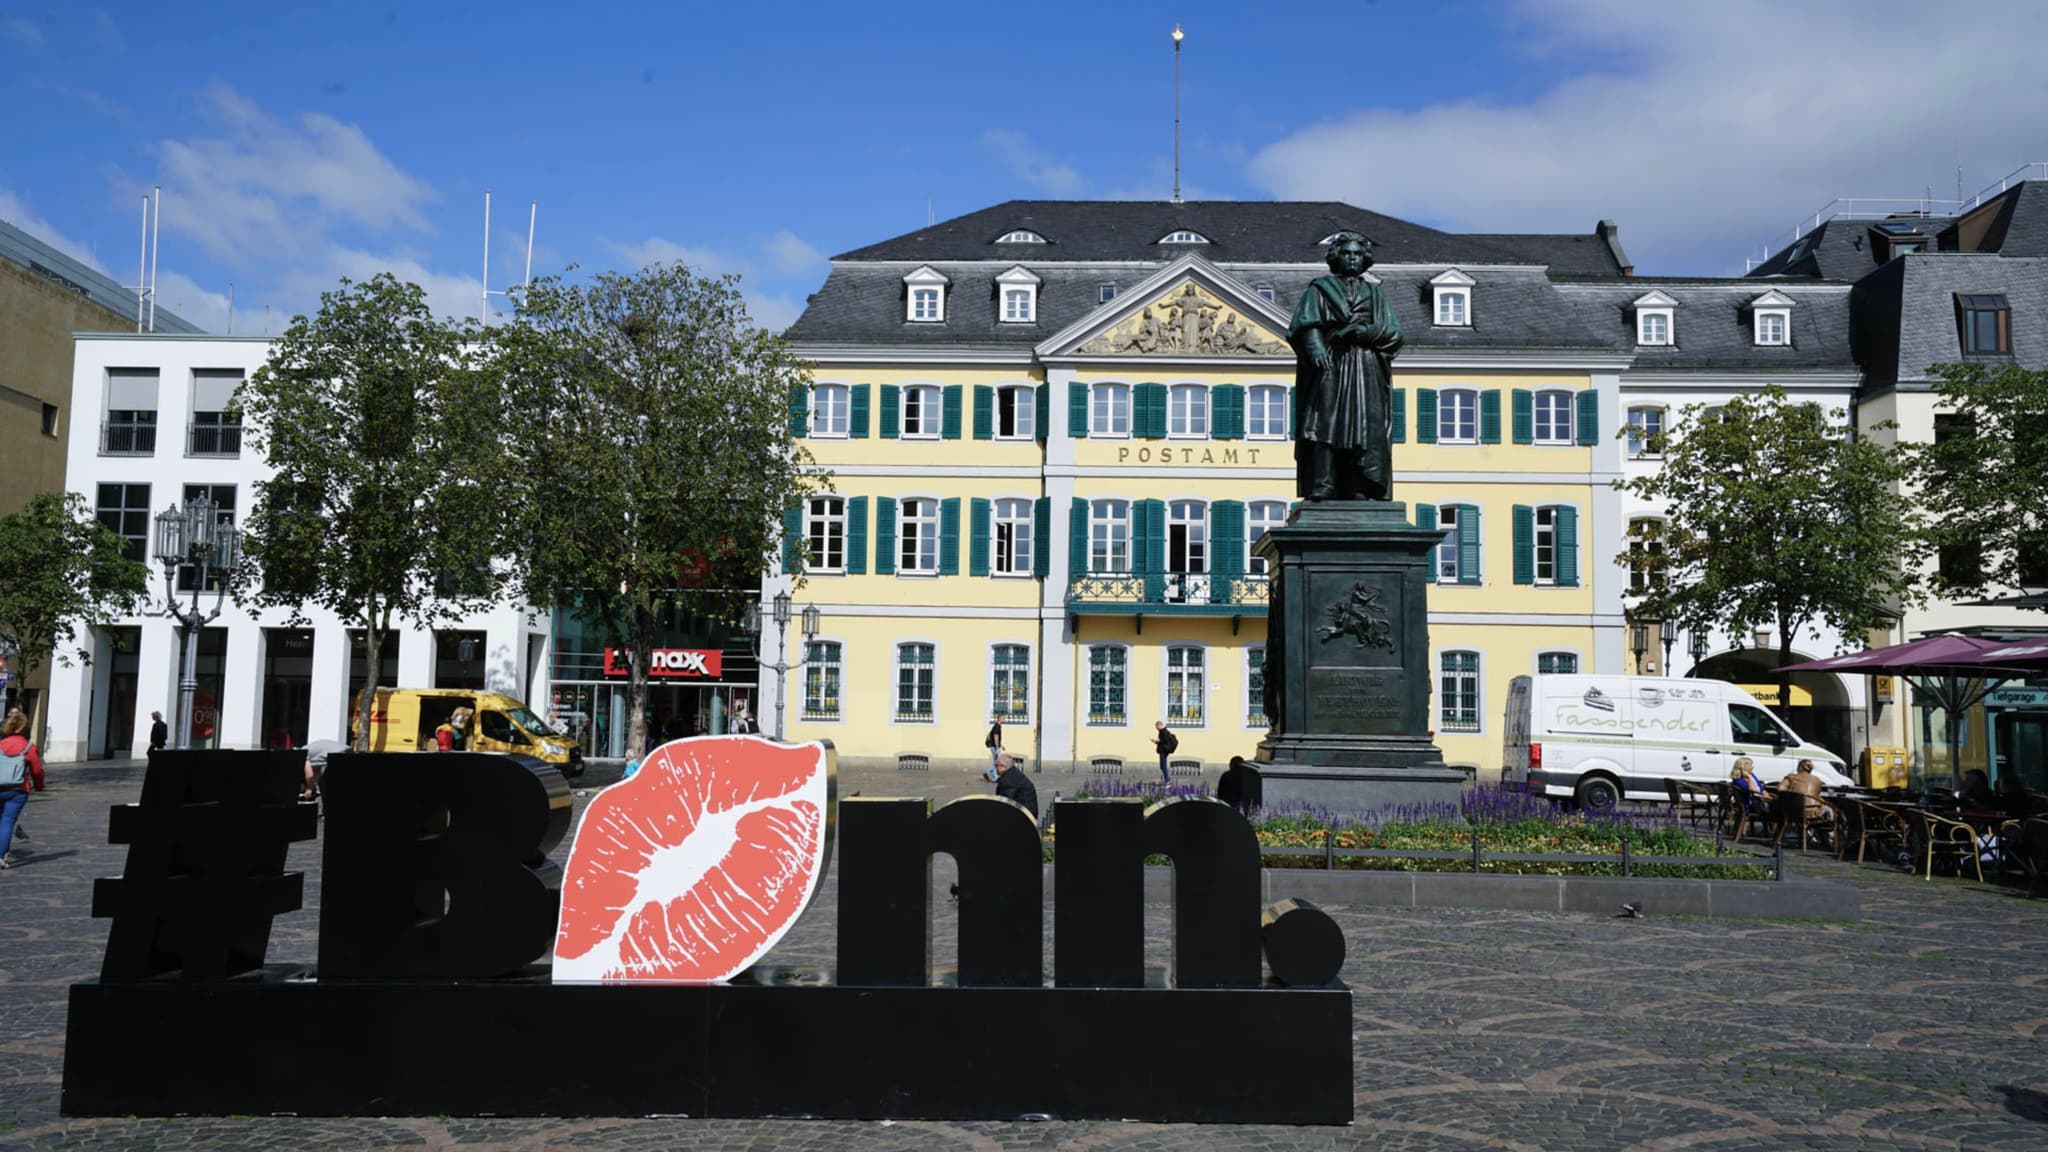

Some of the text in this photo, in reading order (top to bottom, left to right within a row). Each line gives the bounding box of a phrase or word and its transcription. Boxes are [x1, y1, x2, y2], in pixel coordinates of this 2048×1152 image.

[1118, 447, 1260, 464] POSTAMT
[1992, 690, 2036, 704] Tiefgarage
[1555, 704, 1712, 732] Fassbender
